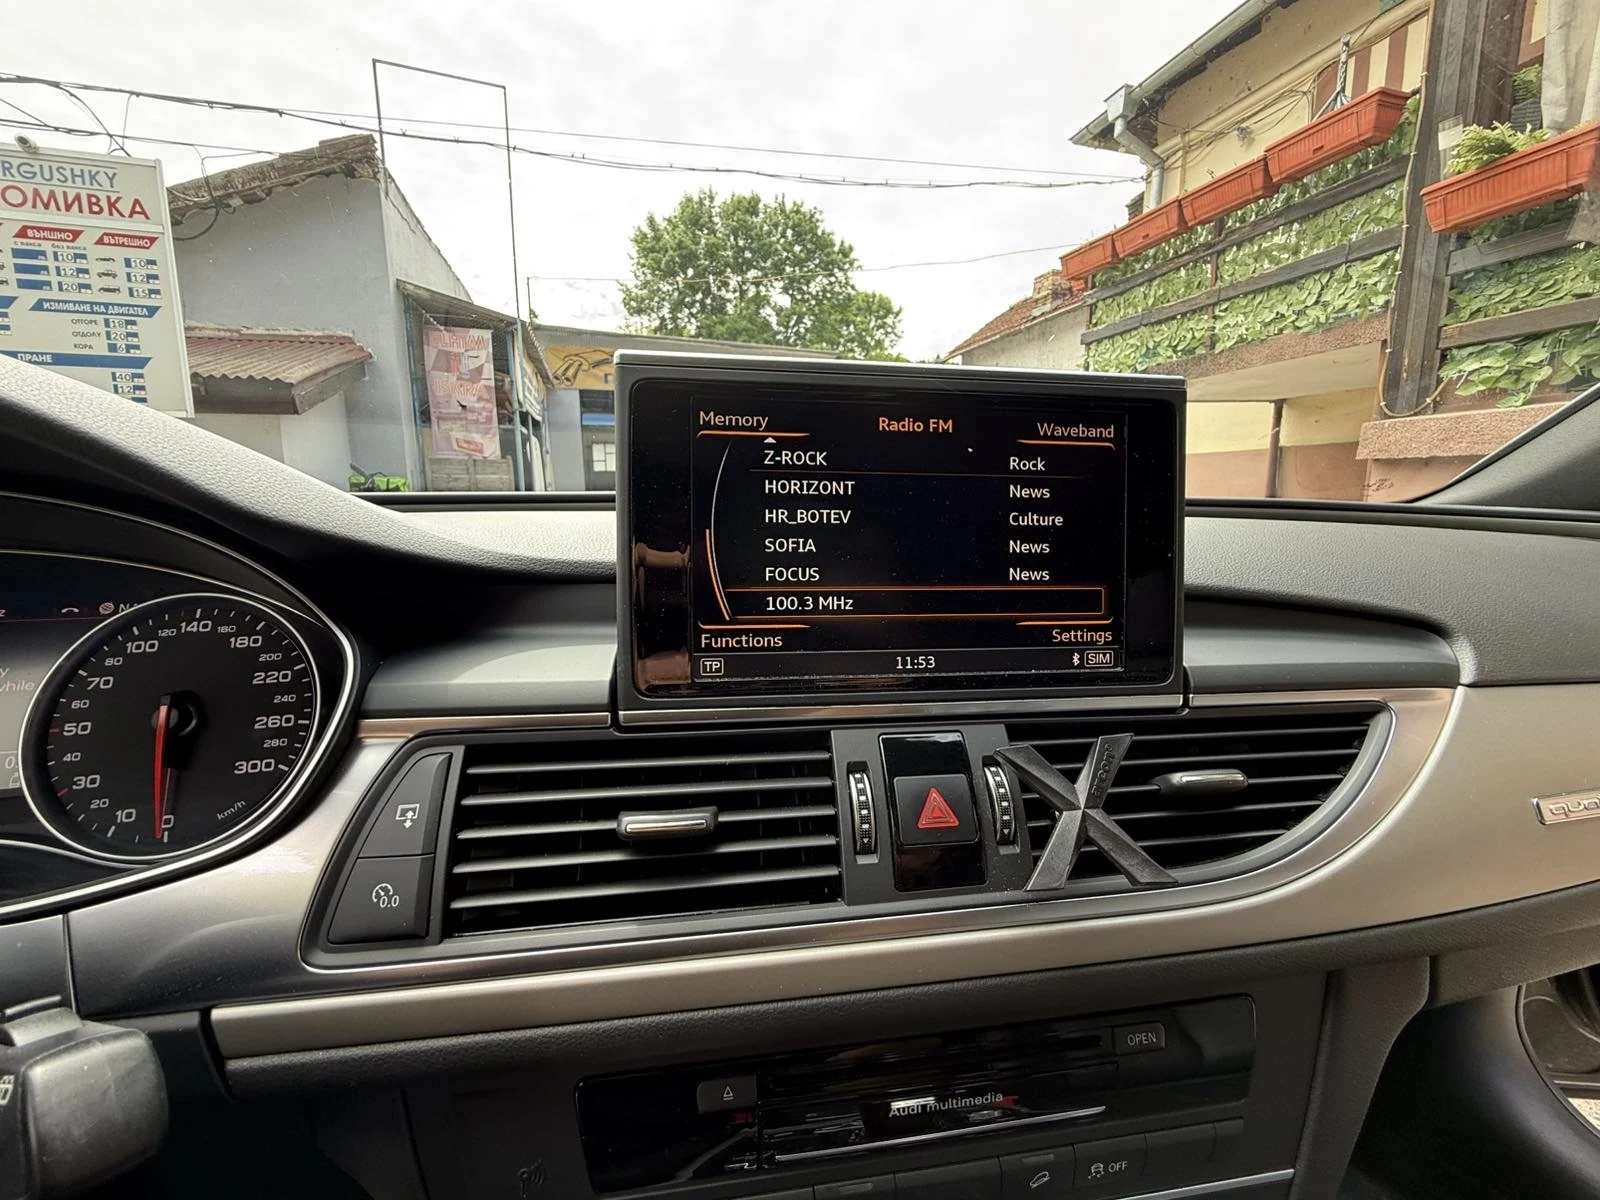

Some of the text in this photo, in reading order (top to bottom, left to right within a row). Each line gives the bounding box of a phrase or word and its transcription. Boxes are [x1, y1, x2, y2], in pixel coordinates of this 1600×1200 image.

[1, 160, 118, 188] RGUSHKY
[1, 185, 152, 220] ОМИВКА
[27, 229, 73, 240] ВЪНШНО
[103, 235, 150, 247] ВЪТРЕШНО
[60, 253, 73, 261] 10
[133, 260, 146, 268] 10
[62, 268, 76, 276] 12
[133, 274, 146, 282] 12
[63, 283, 78, 291] 20
[43, 301, 148, 316] ИЗМИВАНЕ НА ДВИГАТЕЛ
[112, 320, 125, 328] 18
[112, 332, 126, 340] 20
[118, 344, 125, 352] 6
[17, 353, 52, 362] ПРАНЕ
[117, 373, 132, 381] 40
[119, 385, 133, 394] 12
[699, 410, 769, 432] Memory
[879, 416, 953, 433] Radio FM
[1037, 422, 1114, 438] Waveband
[763, 450, 828, 466] Z-ROCK
[1009, 456, 1046, 471] Rock
[765, 479, 856, 495] HORIZONT
[1009, 484, 1050, 499] News
[765, 508, 852, 526] HR_BOTEV
[1009, 511, 1065, 526] Culture
[764, 538, 817, 553] SOFIA
[1009, 539, 1050, 554] News
[765, 567, 820, 582] FOCUS
[1009, 567, 1050, 582] News
[766, 595, 854, 611] 100.3 MHz
[158, 628, 177, 637] 120
[180, 620, 212, 633] 140
[217, 625, 236, 633] 160
[229, 635, 262, 648] 180
[701, 633, 783, 648] Functions
[1052, 628, 1113, 646] Settings
[126, 640, 159, 654] 100
[105, 657, 123, 665] 80
[259, 652, 282, 661] 200
[895, 656, 936, 669] 11:53
[1087, 653, 1111, 666] SIM
[703, 661, 721, 672] TP
[87, 676, 114, 690] 70
[252, 670, 292, 684] 220
[71, 699, 90, 709] 60
[273, 694, 296, 703] 240
[63, 721, 92, 736] 50
[254, 714, 294, 729] 260
[263, 738, 288, 748] 280
[63, 752, 81, 762] 40
[234, 759, 275, 774] 300
[72, 774, 101, 790] 30
[90, 799, 110, 809] 20
[217, 800, 246, 820] km/h
[115, 808, 137, 823] 10
[162, 814, 174, 828] 0
[380, 895, 399, 908] 0.0
[1127, 1031, 1157, 1046] OPEN
[888, 1091, 1004, 1118] Audi multimedia
[1107, 1160, 1128, 1173] OFF
